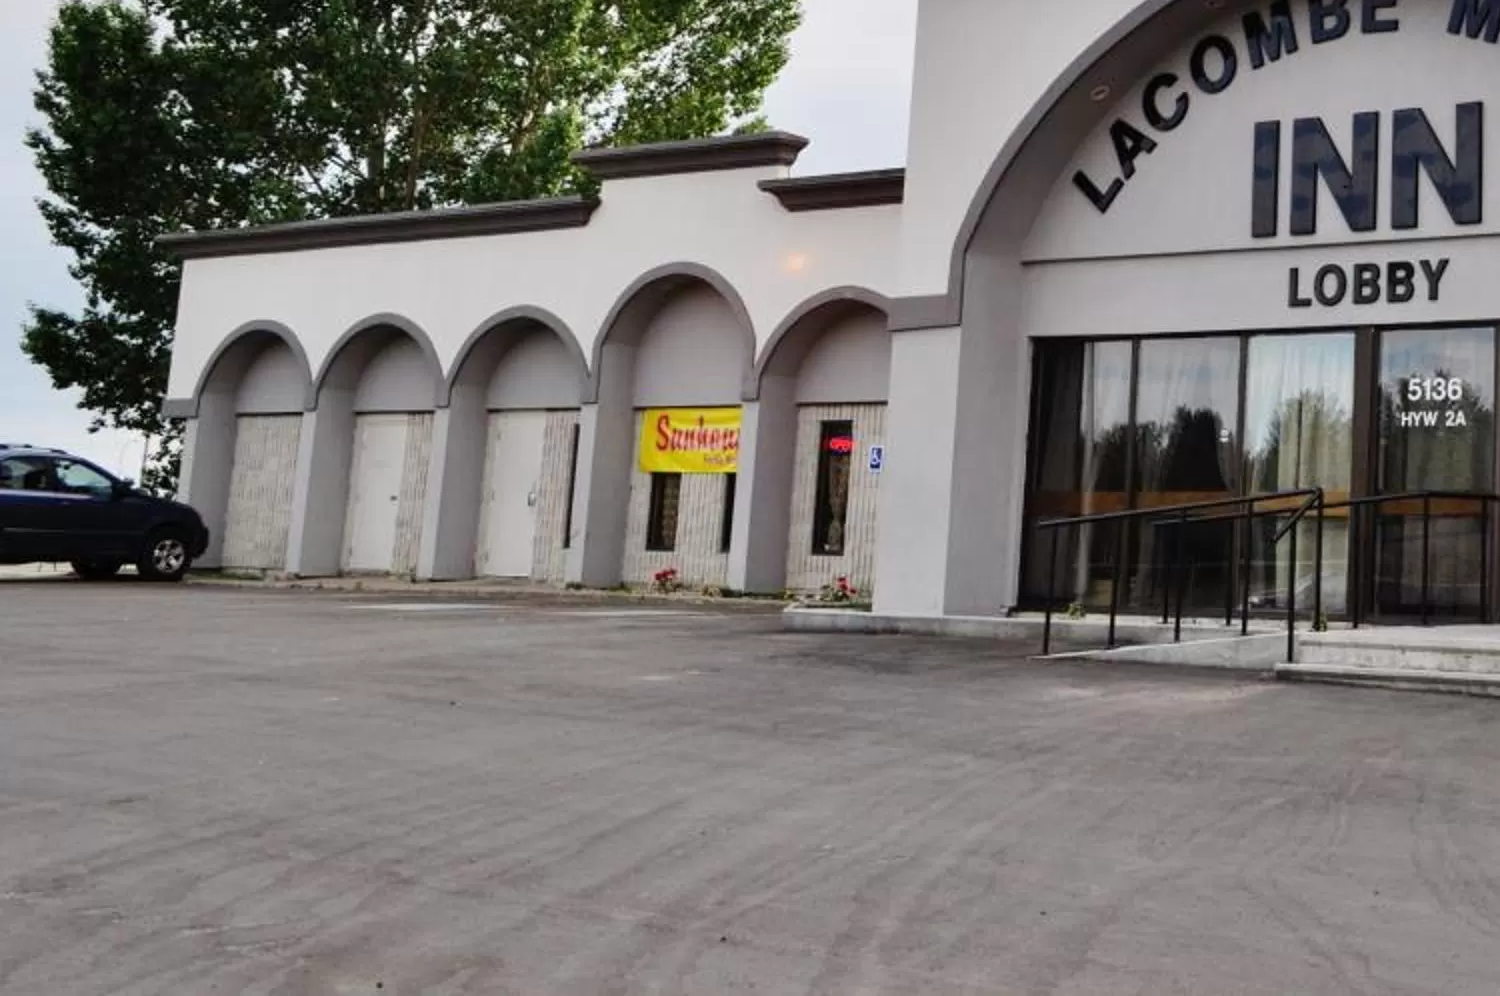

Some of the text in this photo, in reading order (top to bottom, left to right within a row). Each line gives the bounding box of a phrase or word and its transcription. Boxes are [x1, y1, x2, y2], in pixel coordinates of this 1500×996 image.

[1251, 101, 1484, 239] INN
[1287, 258, 1450, 308] LOBBY
[1407, 377, 1463, 402] 5136
[1400, 409, 1467, 427] HYW 2A
